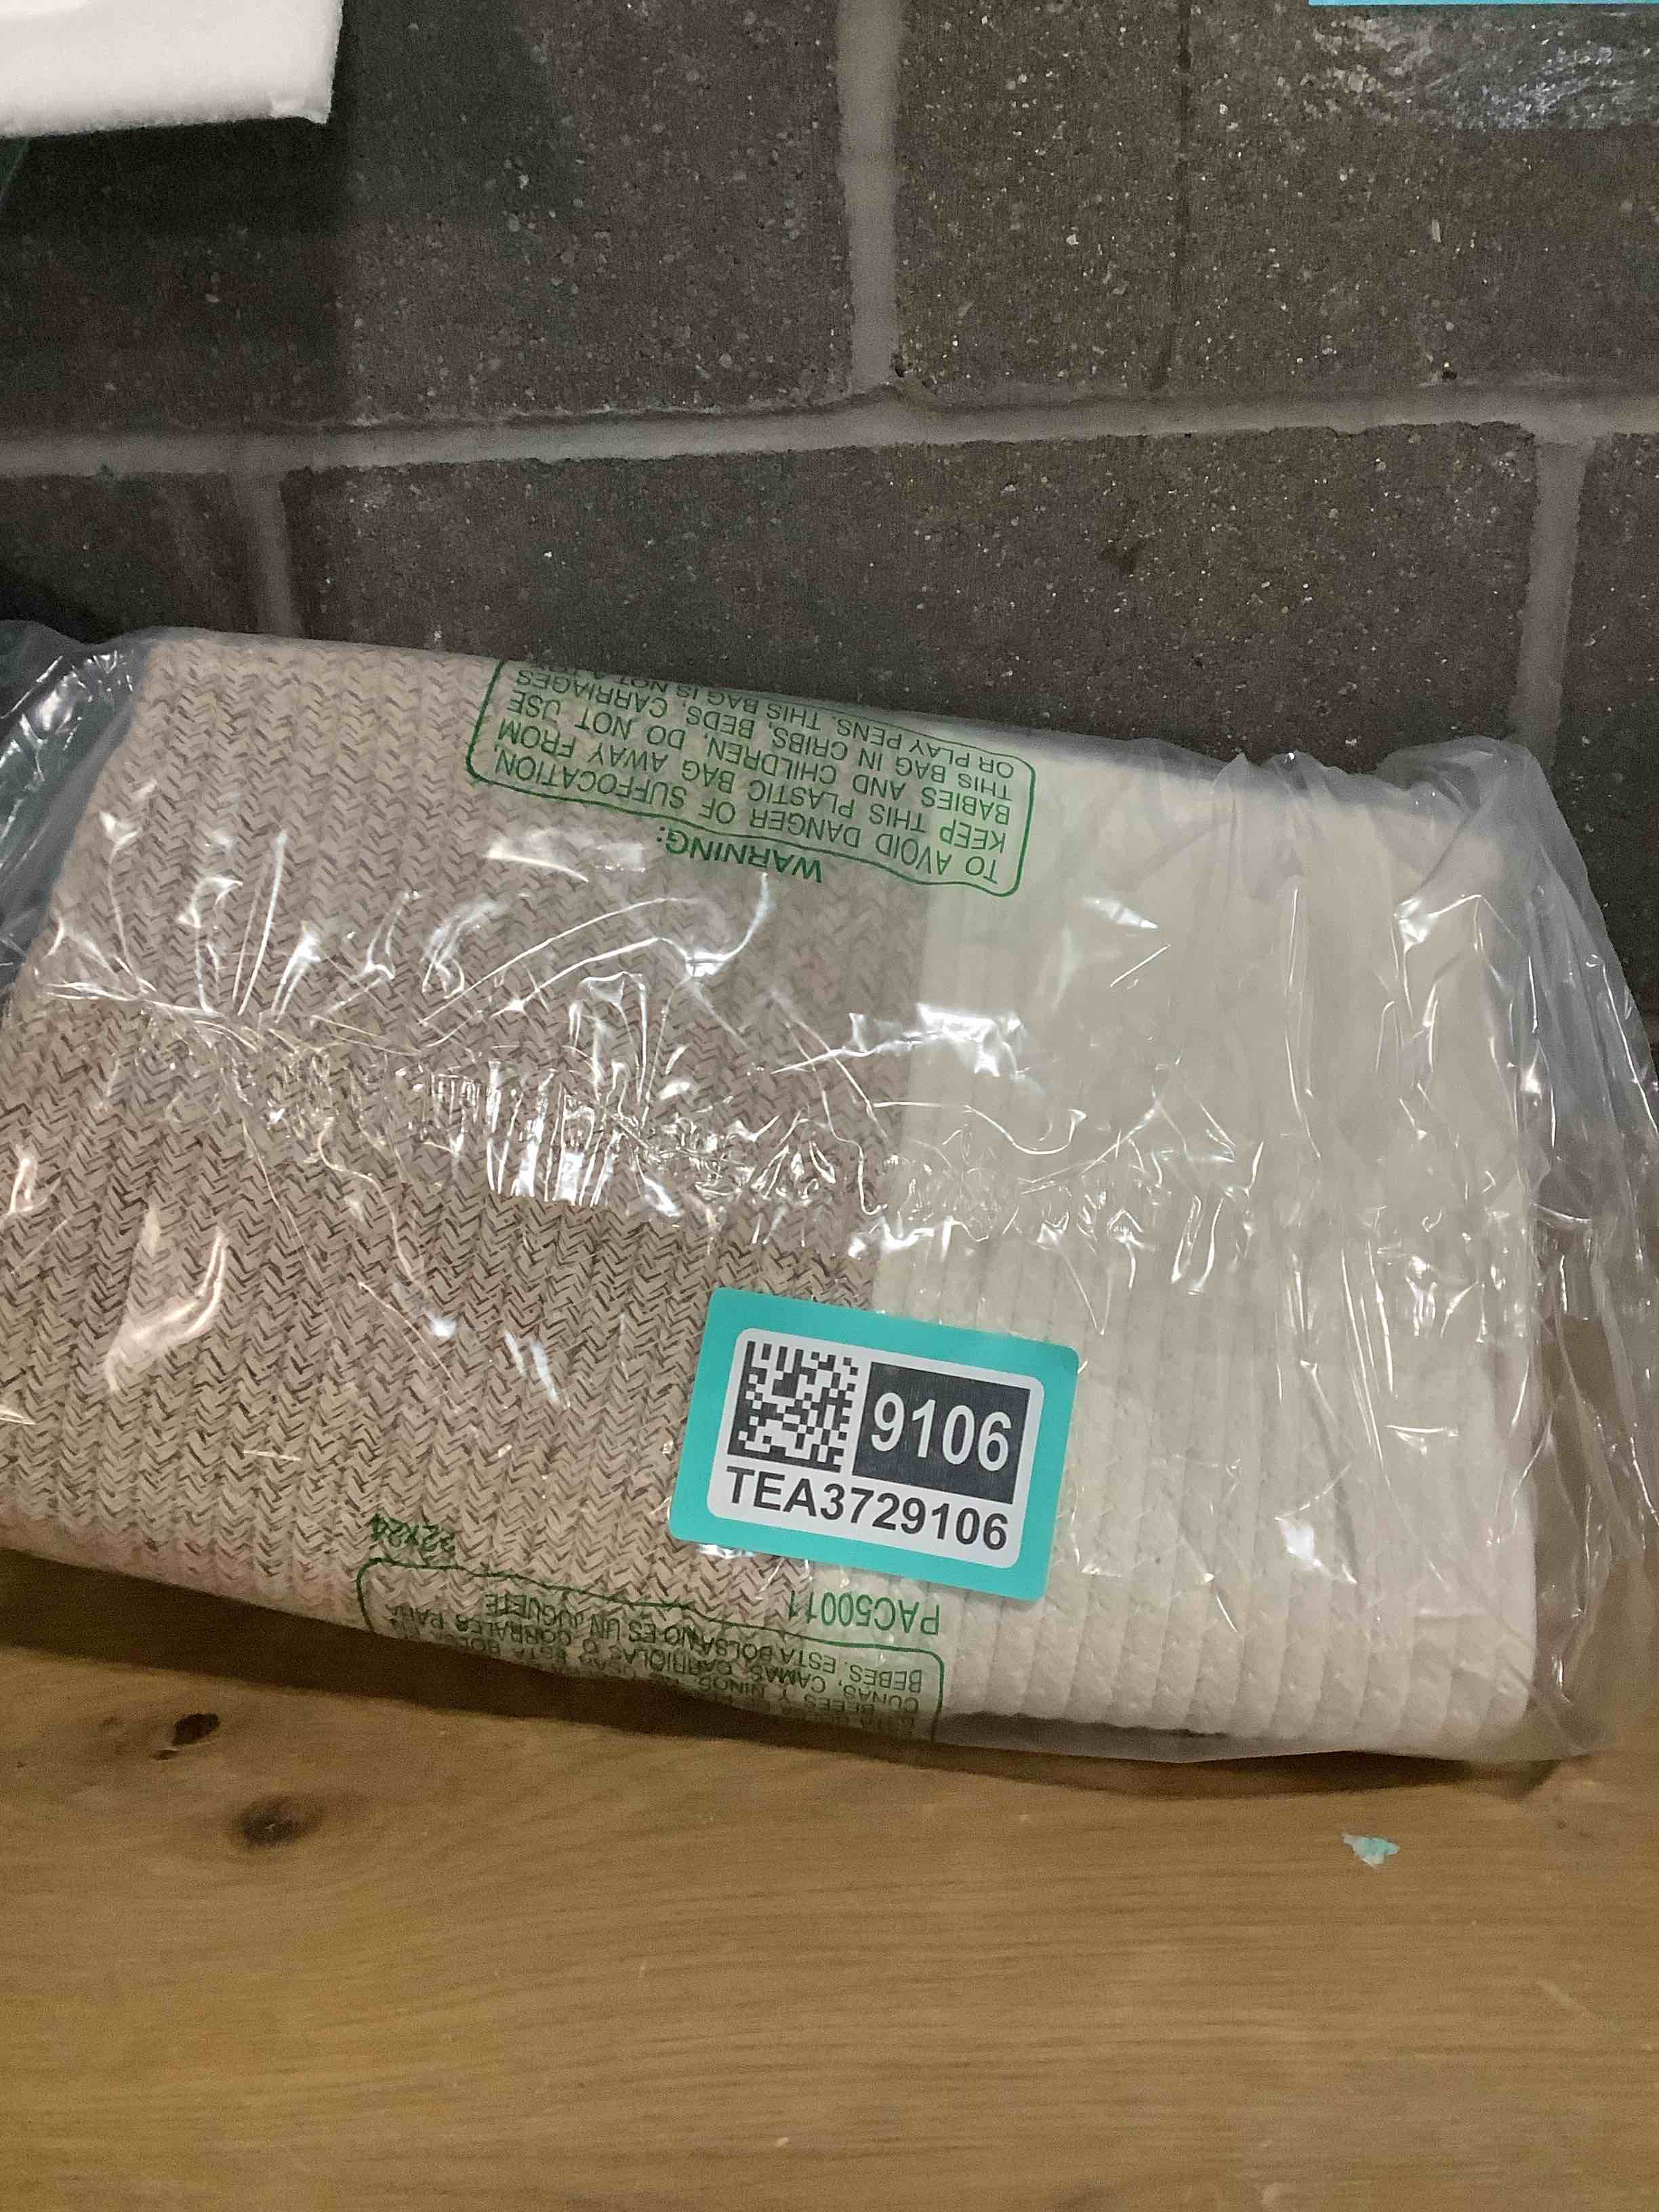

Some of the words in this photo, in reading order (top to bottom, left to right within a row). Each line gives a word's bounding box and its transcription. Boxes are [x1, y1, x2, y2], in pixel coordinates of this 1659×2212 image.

[506, 689, 561, 721] USE
[516, 670, 668, 719] CARRIAGES
[707, 690, 760, 714] BAG
[575, 708, 632, 741] NOT
[682, 701, 755, 739] BEDS,
[766, 702, 821, 731] THIS
[831, 716, 903, 750] PENS.
[497, 718, 575, 759] FROM
[646, 725, 686, 751] DO
[768, 722, 849, 761] CRIBS,
[908, 739, 971, 769] PLAY
[587, 741, 669, 773] AWAY
[857, 747, 883, 771] IN
[894, 756, 947, 784] BAG
[979, 756, 1015, 779] OR
[493, 743, 687, 809] SUFFOCATION,
[681, 759, 736, 794] BAG
[852, 773, 907, 801] AND
[957, 773, 1012, 802] THIS
[698, 798, 736, 825] OF
[747, 779, 855, 819] PLASTIC
[920, 785, 1011, 825] BABIES
[749, 808, 862, 848] DANGER
[868, 803, 927, 834] THIS
[939, 819, 1006, 854] KEEP
[656, 826, 822, 884] WARNING:
[875, 833, 952, 876] AVOID
[965, 856, 998, 884] TO
[872, 1392, 1012, 1472] 9106
[726, 1465, 1008, 1551] TEA3729106
[787, 1590, 940, 1636] PAC50011
[701, 1638, 773, 1664] BOLSA
[779, 1647, 836, 1675] ESTA
